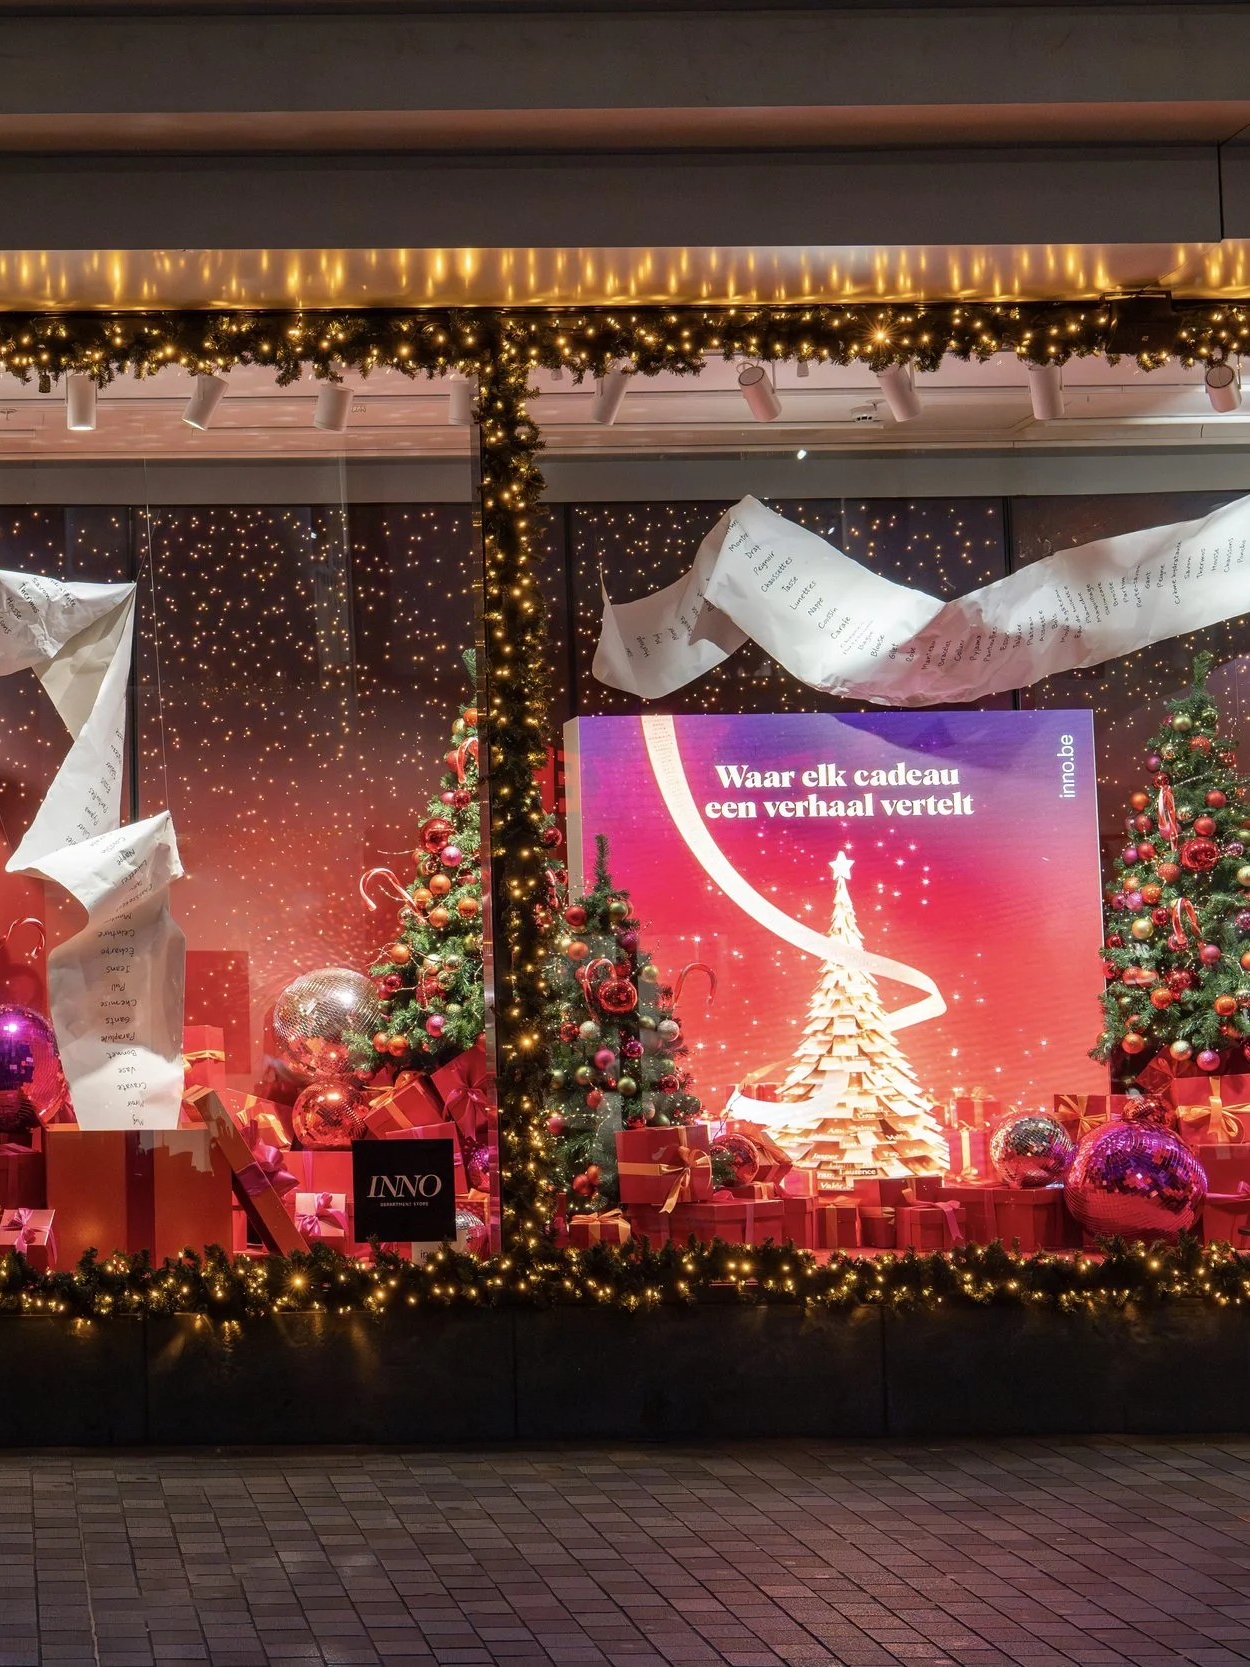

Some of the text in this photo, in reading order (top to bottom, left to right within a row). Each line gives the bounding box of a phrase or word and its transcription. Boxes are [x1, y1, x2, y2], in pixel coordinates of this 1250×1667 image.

[728, 532, 749, 553] Montre
[745, 544, 762, 559] Drap
[1237, 539, 1247, 564] Poncho
[753, 550, 775, 576] Peignoir
[1196, 548, 1206, 579] Thermos
[1211, 548, 1220, 572] Housse
[1223, 537, 1234, 573] Chaussons
[760, 556, 793, 593] Chaussettes
[1156, 564, 1166, 588] Peigne
[1184, 556, 1192, 580] Savon
[31, 577, 52, 602] Savon
[781, 576, 799, 593] Tasse
[790, 580, 817, 610] Lunettes
[1109, 582, 1119, 607] Brosse
[1120, 576, 1129, 603] Parfum
[5, 596, 22, 620] Housse
[19, 582, 41, 614] Thermos
[807, 597, 824, 616] Nappe
[1077, 592, 1092, 624] Planche
[1086, 584, 1101, 623] Maquillage
[818, 607, 838, 630] Coussin
[830, 616, 851, 640] Carafe
[870, 634, 885, 657] Blouse
[921, 640, 936, 670] Manteau
[715, 761, 960, 788] Waar elk cadeau
[1057, 734, 1075, 798] inno.be
[704, 791, 975, 819] een verhaal vertelt
[116, 848, 136, 866] Nappe
[97, 929, 135, 939] Ceinture
[100, 947, 135, 958] Écharpe
[105, 965, 131, 974] Jeans
[111, 982, 126, 992] Pull
[100, 998, 137, 1008] Chemise
[105, 1016, 131, 1026] Gants
[100, 1032, 136, 1043] Parapluie
[106, 1049, 137, 1060] Bonnet
[118, 1066, 136, 1075] Vase
[117, 1081, 147, 1091] Cravate
[839, 1167, 877, 1176] Laurence
[366, 1174, 442, 1198] INNO
